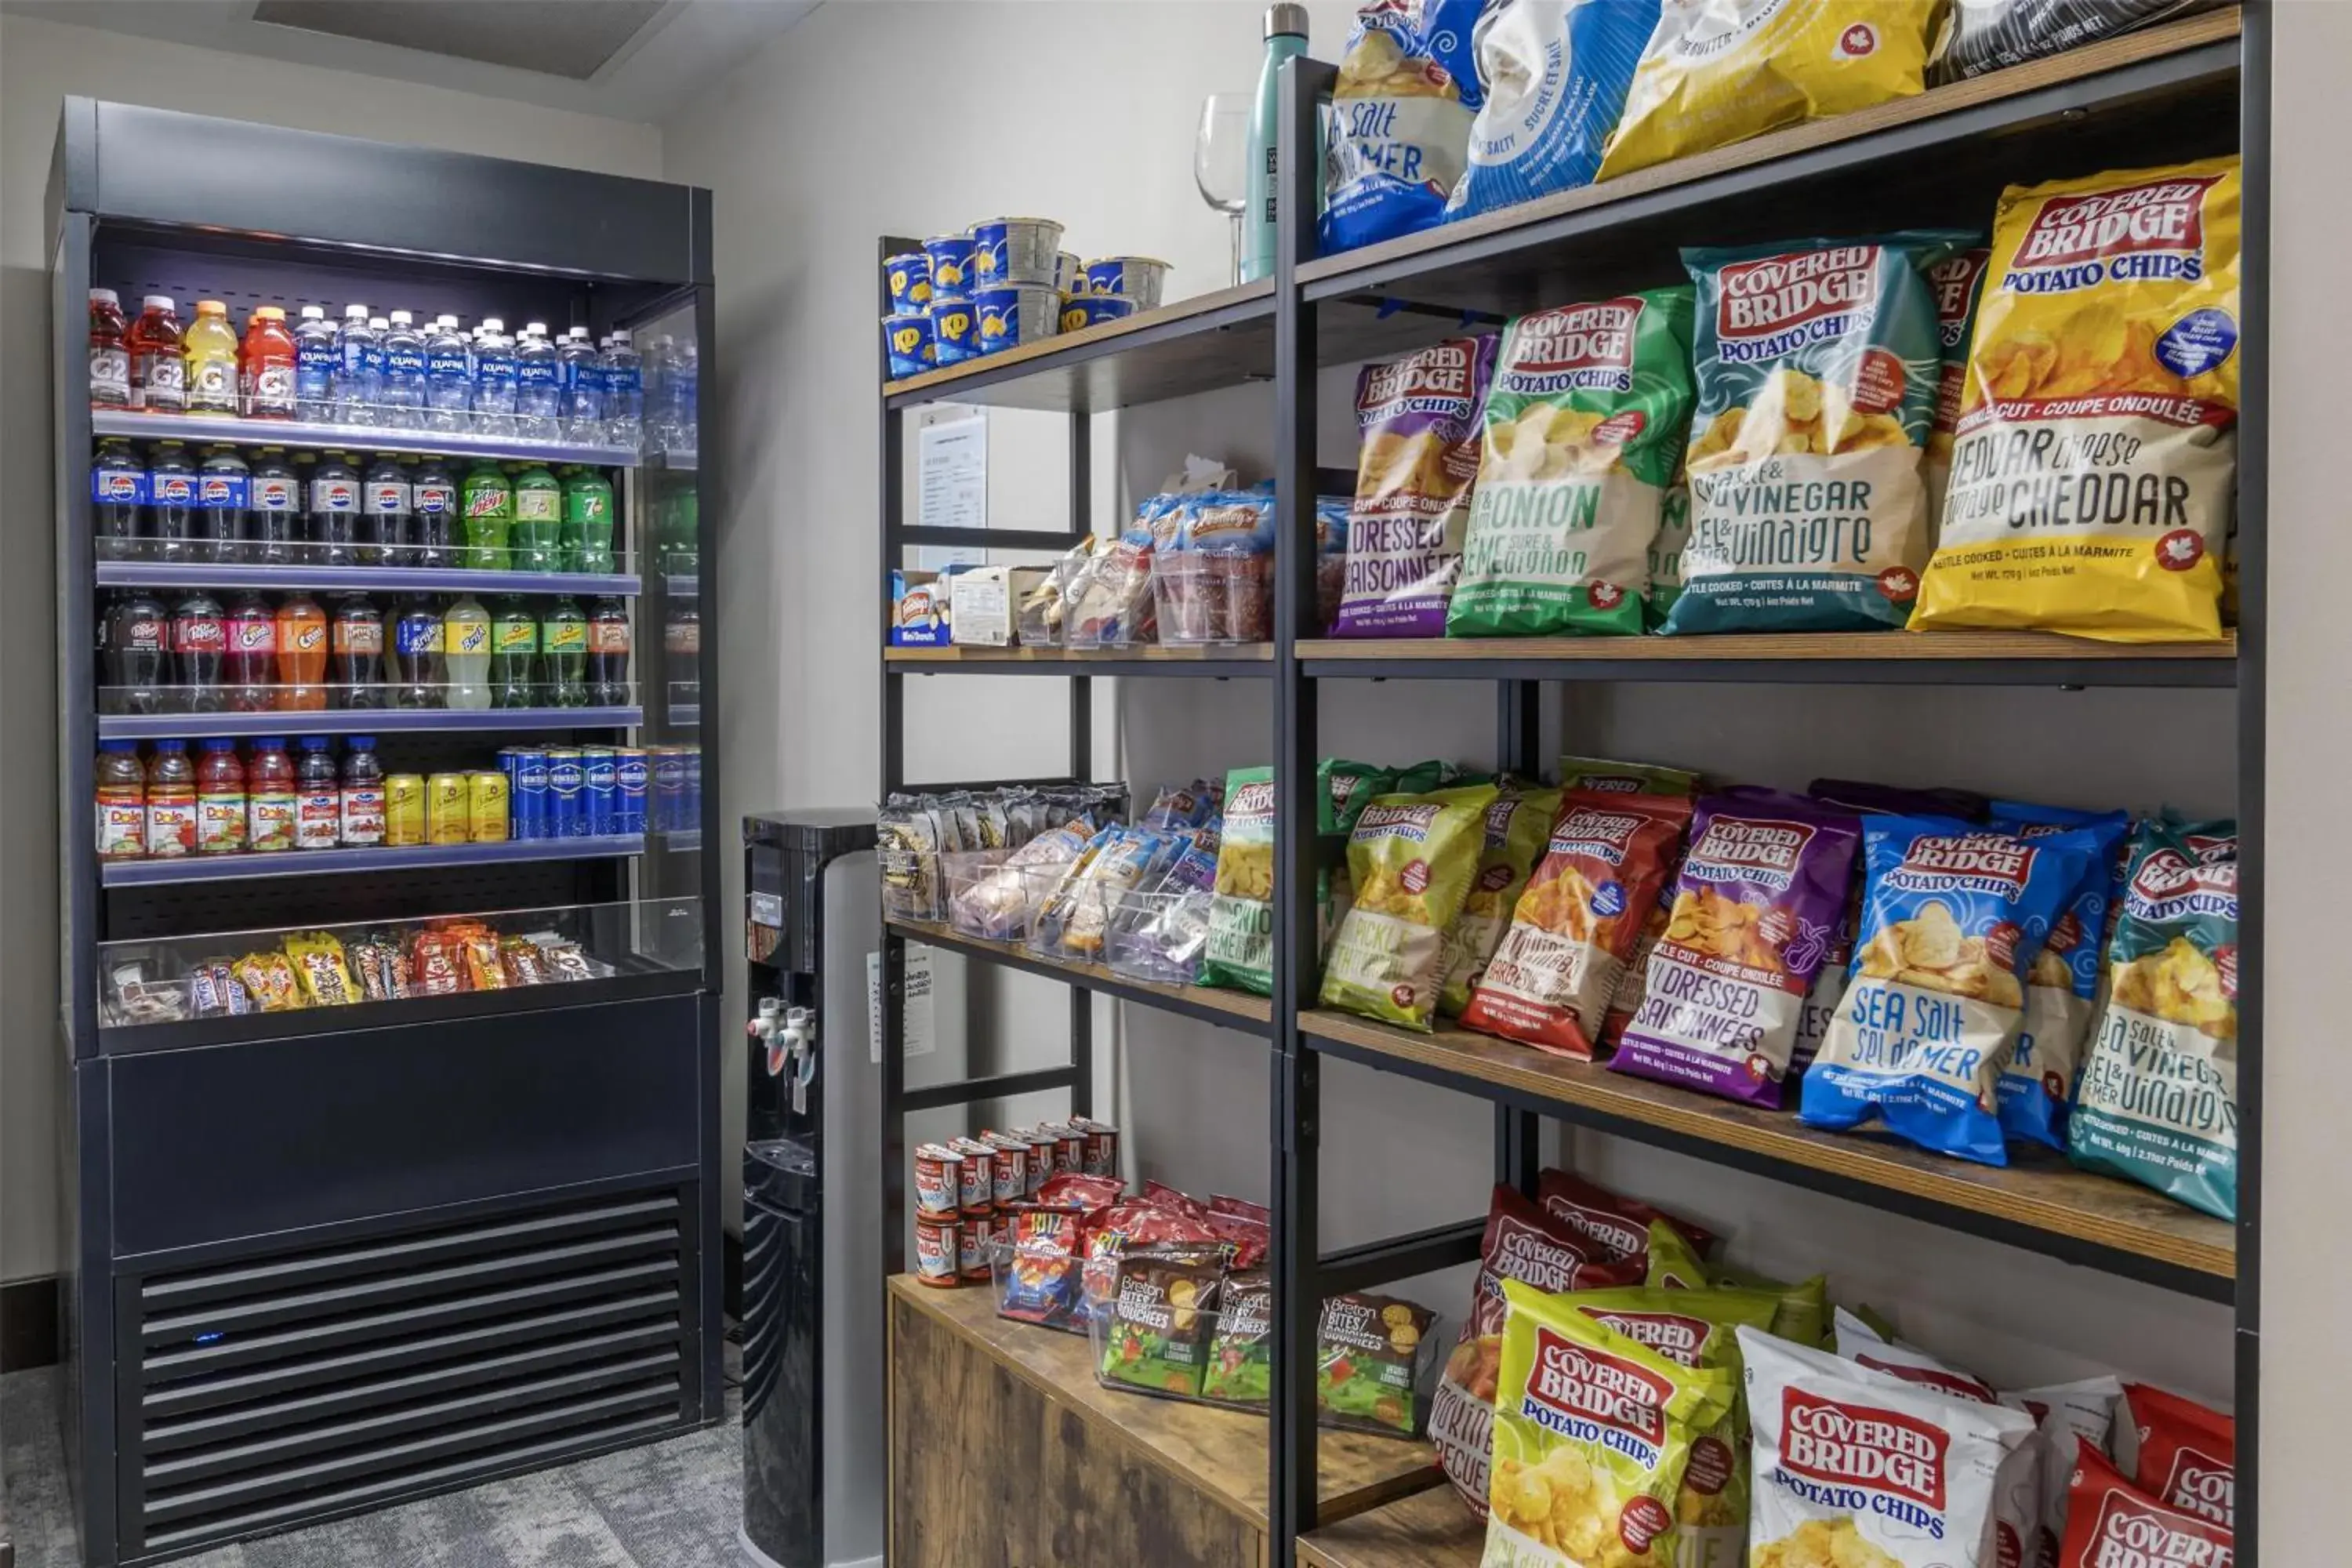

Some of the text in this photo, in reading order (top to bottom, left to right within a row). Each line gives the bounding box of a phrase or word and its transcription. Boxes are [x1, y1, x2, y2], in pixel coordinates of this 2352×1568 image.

[2043, 183, 2202, 230] COVERED
[2027, 205, 2191, 260] BRIDGE
[1729, 245, 1869, 297] COVERED
[2005, 255, 2202, 292] POTATO CHIPS
[1730, 270, 1867, 329] BRIDGE
[1521, 304, 1635, 336] COVERED
[1513, 330, 1626, 365] BRIDGE
[1721, 331, 1804, 361] POTATO
[1367, 368, 1465, 403] BRIDGE
[1574, 371, 1632, 392] CHIPS
[1410, 398, 1472, 419] CHIPS
[1997, 401, 2035, 418] CUT
[2043, 397, 2106, 416] COUPE
[1733, 481, 1871, 516] VINEGAR
[2009, 473, 2189, 528] CHEDDAR
[1569, 813, 1639, 829] COVERED
[1709, 822, 1801, 847] COVERED
[1700, 838, 1794, 866] BRIDGE
[1741, 868, 1790, 889] CHIPS
[1885, 871, 2020, 902] POTATO CHIPS
[1661, 966, 1759, 1018] DRESSED
[1852, 986, 1906, 1033] SEA
[1504, 1232, 1575, 1271] COVERED
[1544, 1345, 1657, 1405] COVERED
[1537, 1367, 1657, 1435] BRIDGE
[1524, 1399, 1599, 1441] POTATO
[1602, 1429, 1659, 1470] CHIPS
[1790, 1405, 1936, 1463] COVERED
[1788, 1428, 1936, 1499] BRIDGE
[1774, 1467, 1944, 1541] POTATO CHIPS
